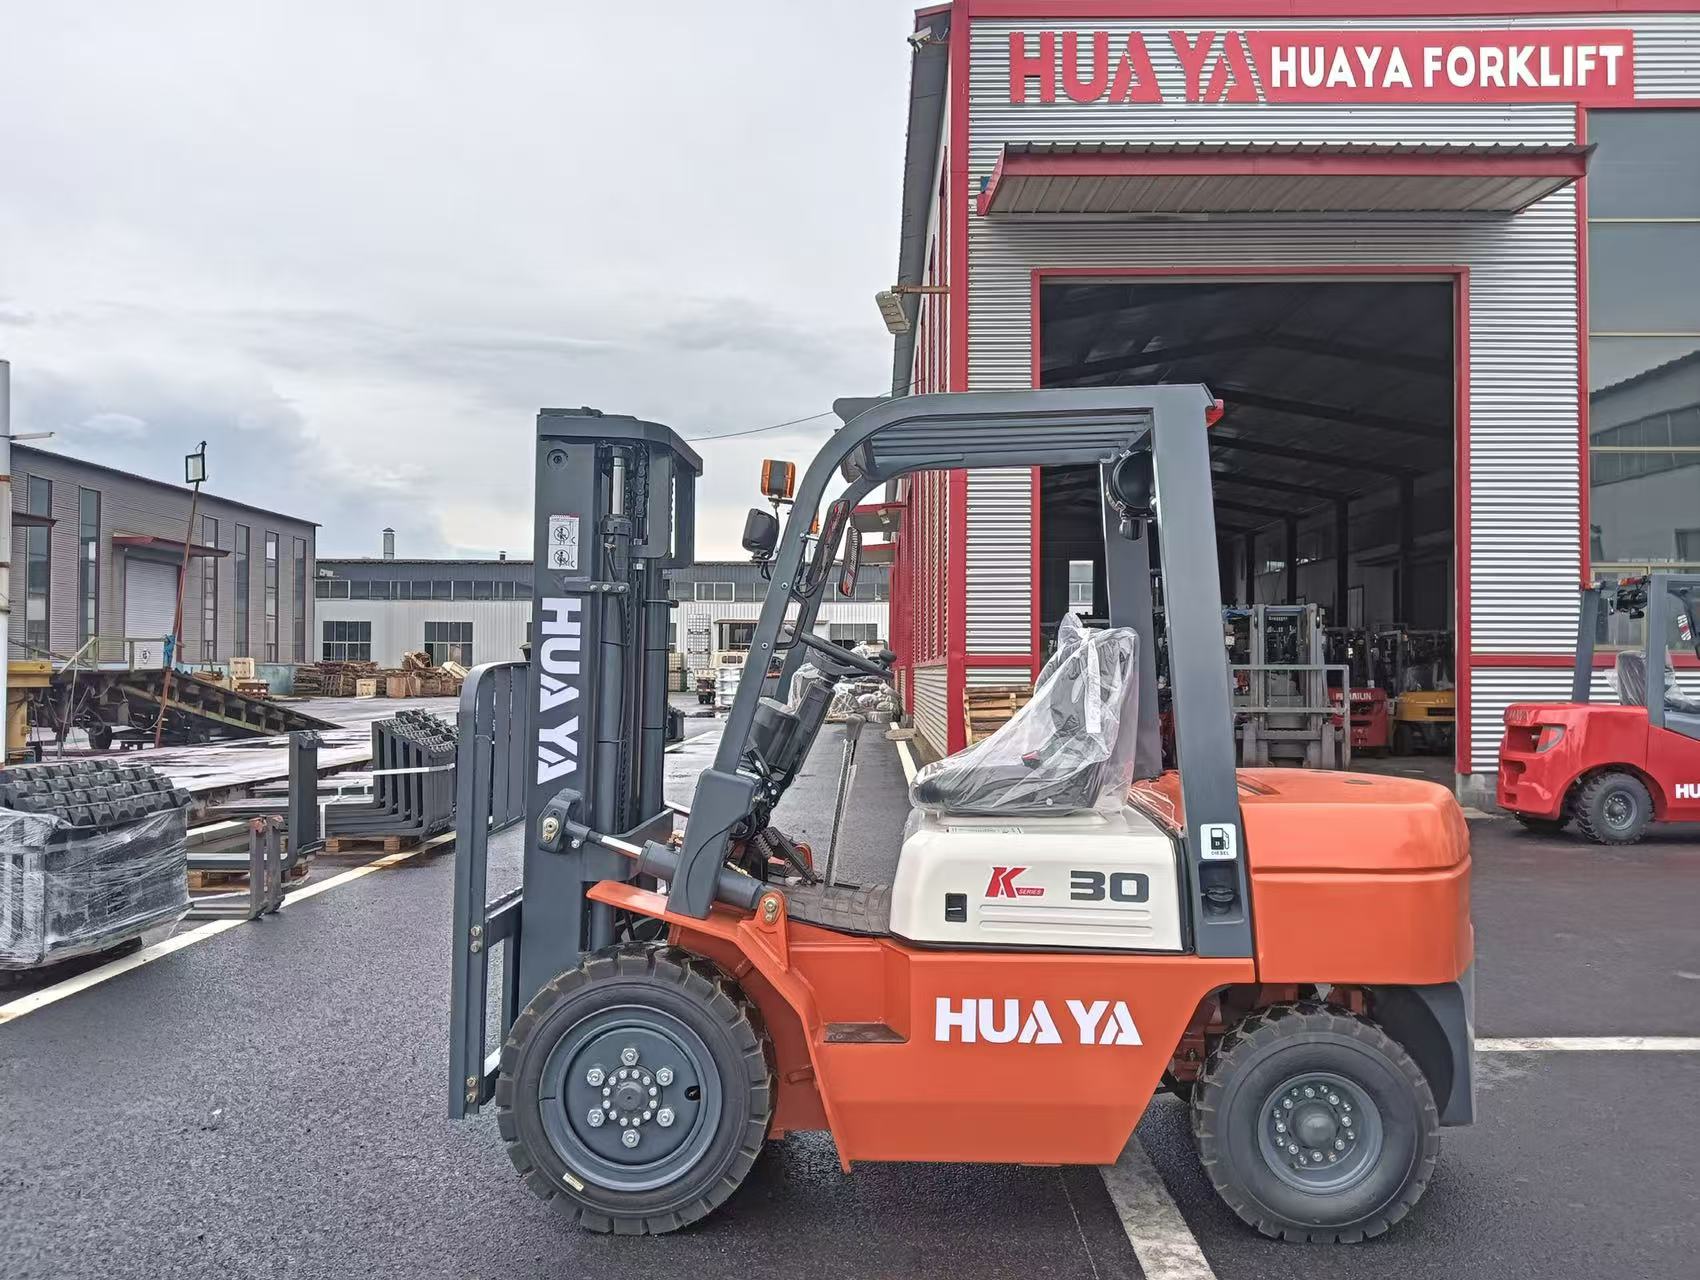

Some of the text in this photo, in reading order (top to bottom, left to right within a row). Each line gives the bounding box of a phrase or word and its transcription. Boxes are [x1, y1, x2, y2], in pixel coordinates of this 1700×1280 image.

[1271, 45, 1624, 88] HUAYA FORKLIFT
[1675, 783, 1700, 799] HU
[985, 866, 1027, 898] K
[1070, 870, 1150, 902] 30
